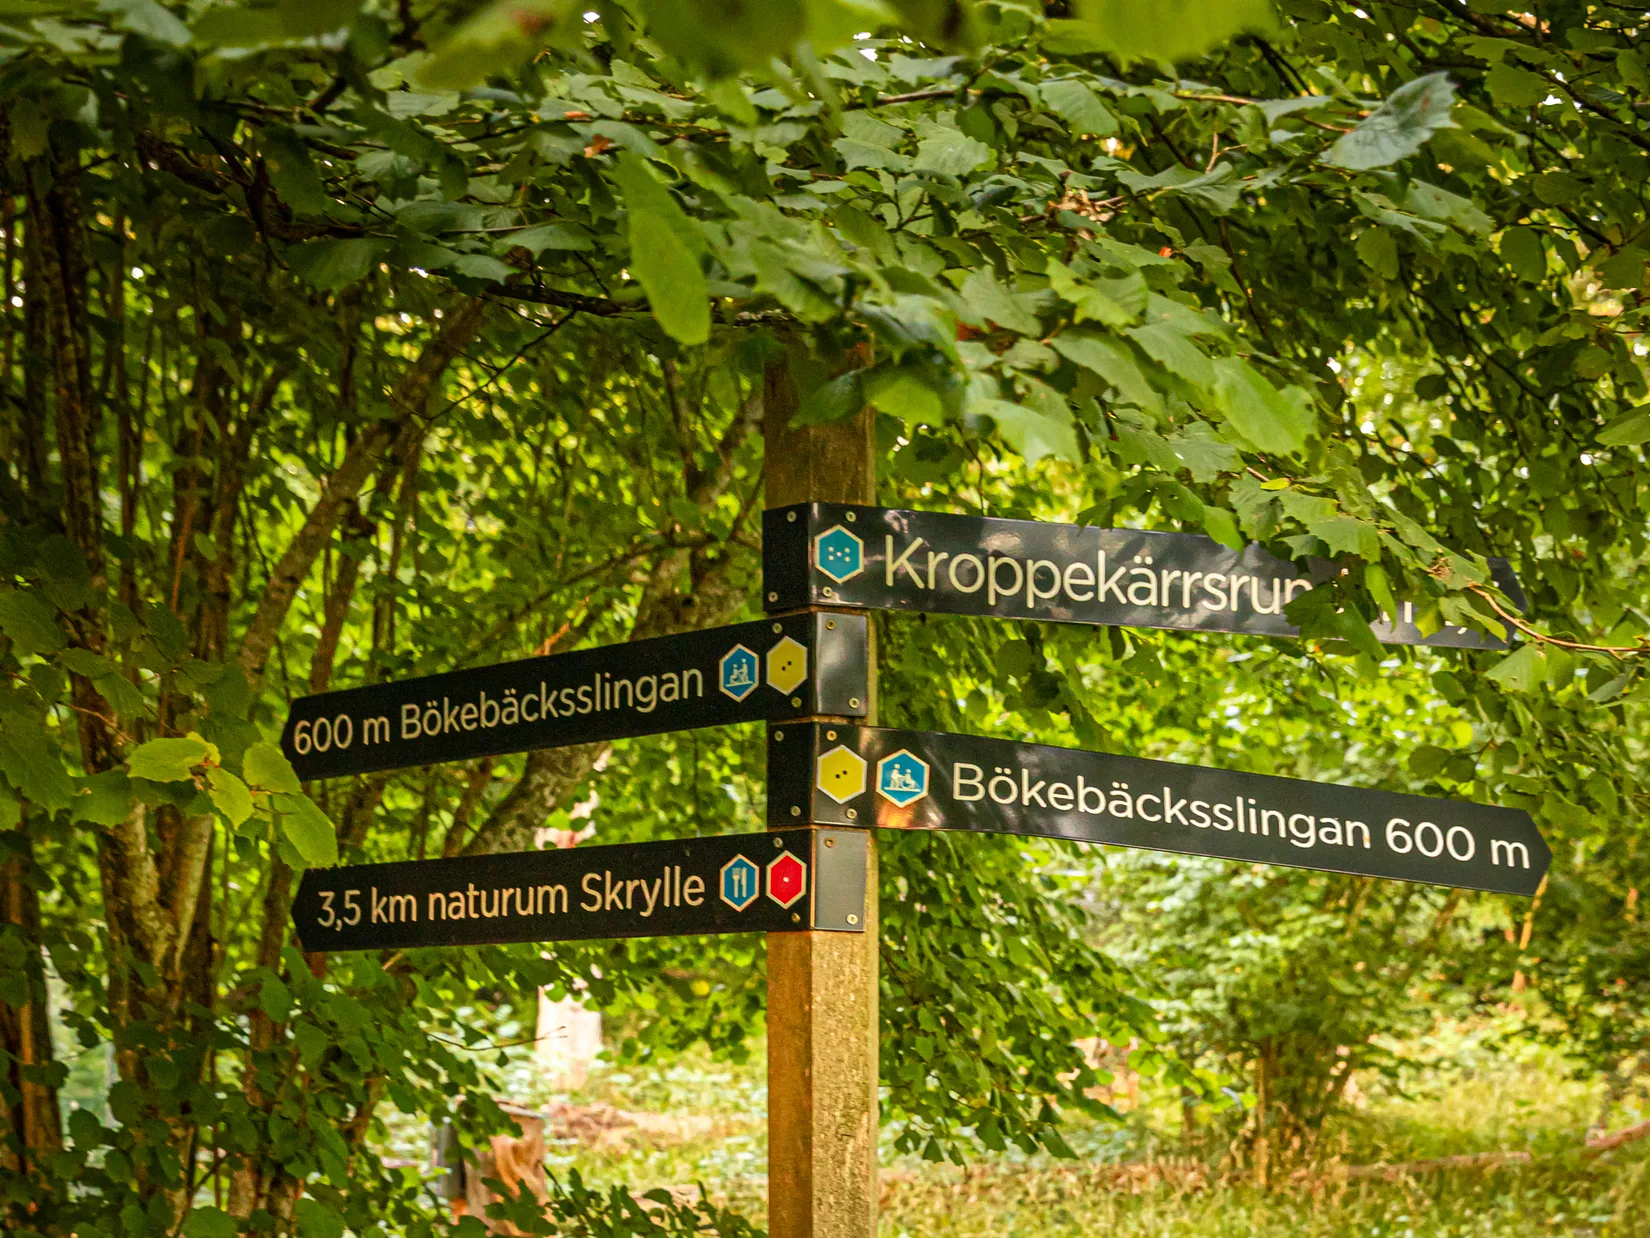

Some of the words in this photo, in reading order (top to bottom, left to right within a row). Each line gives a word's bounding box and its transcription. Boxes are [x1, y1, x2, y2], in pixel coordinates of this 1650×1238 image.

[885, 534, 1413, 625] Kroppekärrsrun
[294, 714, 353, 755] 600
[363, 716, 390, 745] m
[401, 668, 703, 740] Bökebäcksslingan
[952, 761, 1371, 849] Bökebäcksslingan
[1385, 817, 1476, 862] 600
[1490, 838, 1530, 869] m
[317, 889, 361, 932] 3,5
[371, 886, 417, 924] km
[428, 882, 568, 920] naturum
[580, 865, 706, 917] Skrylle
